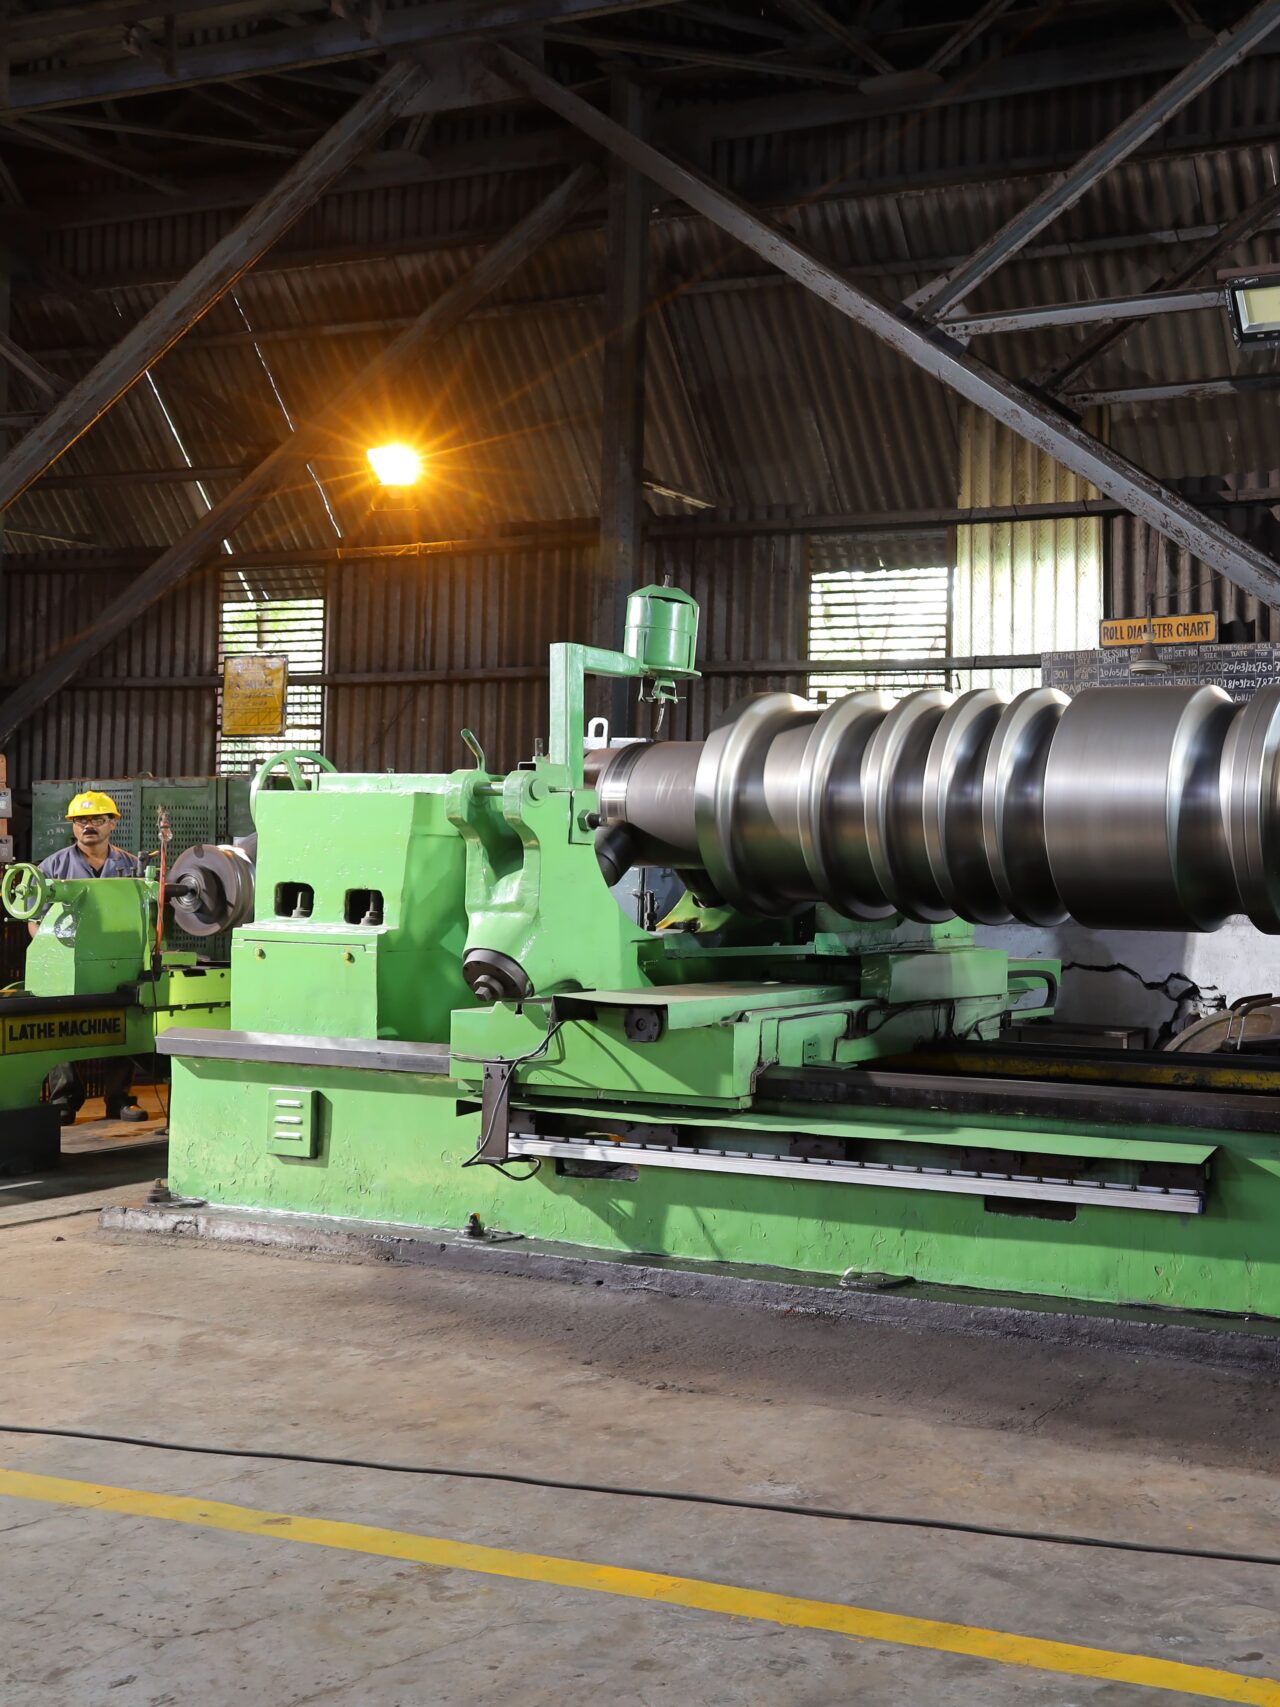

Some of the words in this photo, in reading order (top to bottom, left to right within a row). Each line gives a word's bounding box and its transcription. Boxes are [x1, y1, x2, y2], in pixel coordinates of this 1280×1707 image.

[1103, 626, 1125, 640] ROLL
[1176, 620, 1211, 637] CHART
[1256, 662, 1273, 673] 750
[9, 1023, 56, 1041] LATHE
[58, 1017, 121, 1037] MACHINE
